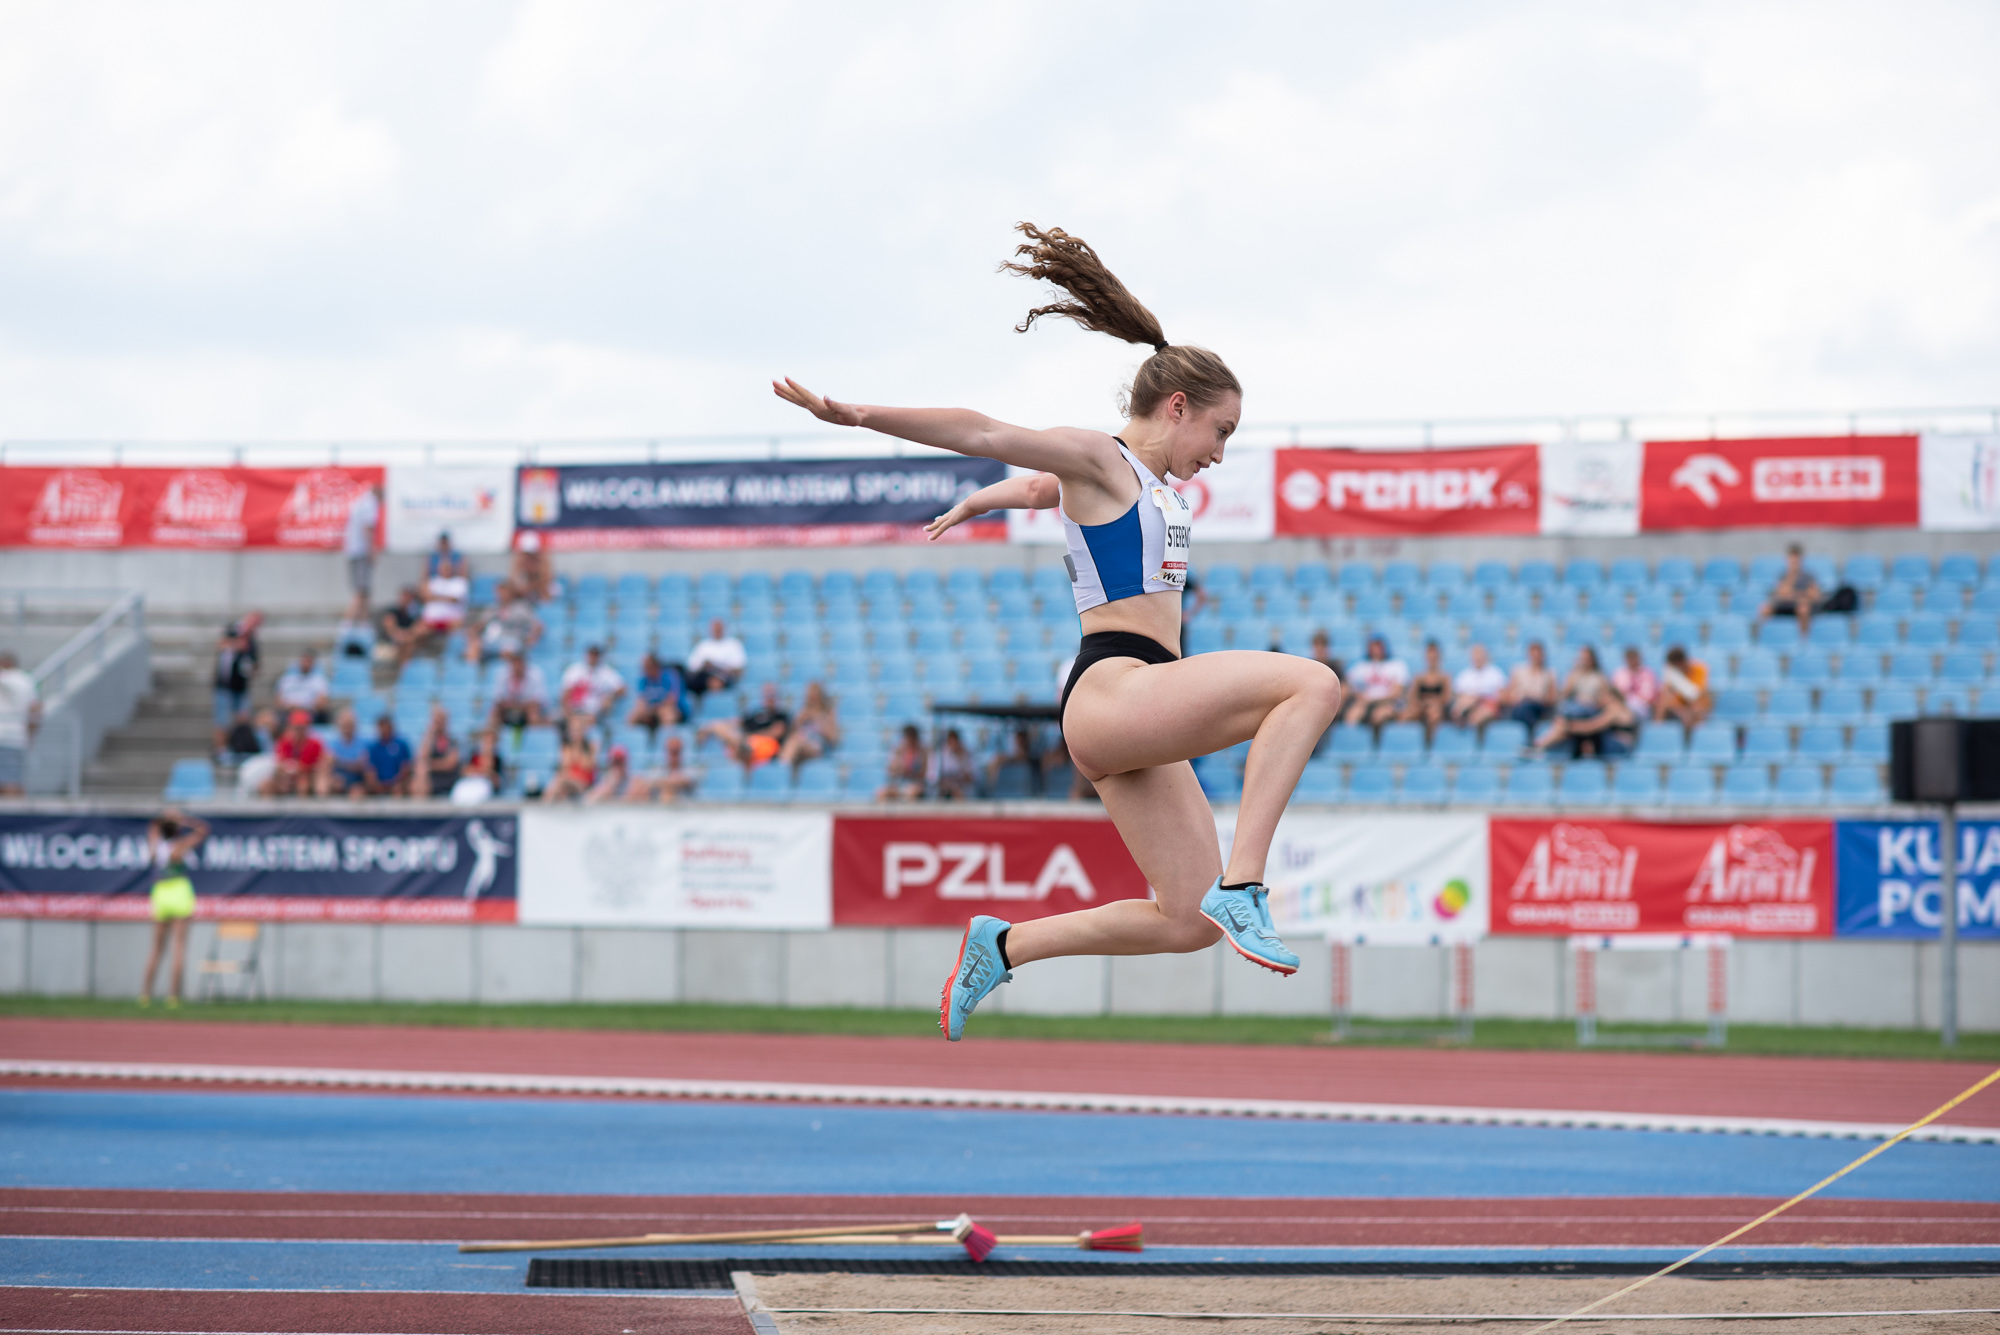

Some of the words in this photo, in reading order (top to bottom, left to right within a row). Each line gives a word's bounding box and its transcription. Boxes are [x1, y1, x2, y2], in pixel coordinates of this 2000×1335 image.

[854, 470, 957, 504] SPORTU
[204, 835, 338, 872] MIASTEM
[342, 835, 458, 873] SPORTU
[883, 843, 1096, 899] PZLA
[1879, 880, 2000, 928] POM
